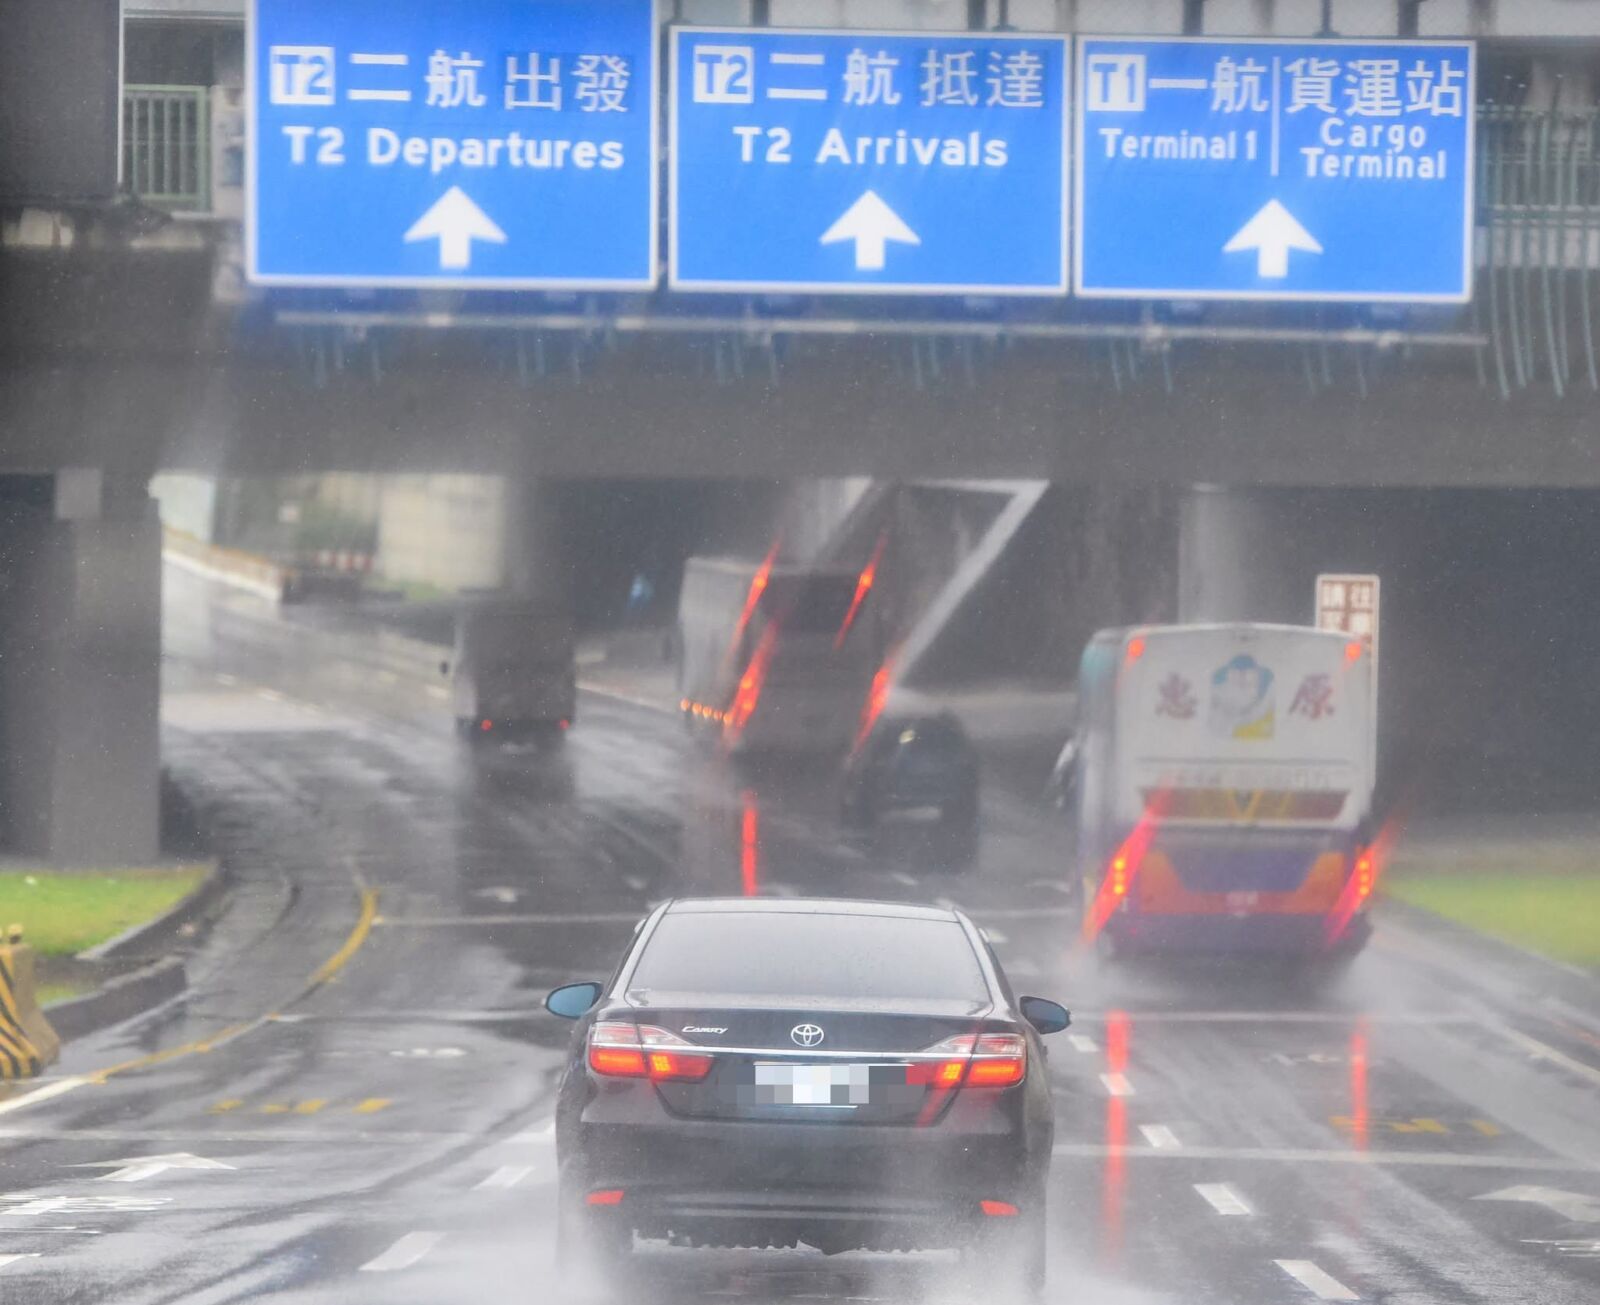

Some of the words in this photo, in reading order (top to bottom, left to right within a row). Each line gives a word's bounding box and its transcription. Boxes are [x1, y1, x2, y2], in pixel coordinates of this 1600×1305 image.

[272, 50, 334, 100] T2
[347, 49, 631, 113] 二航出發
[695, 50, 751, 99] T2
[766, 48, 1044, 108] 二航抵達
[1091, 58, 1141, 107] T1
[1148, 55, 1270, 114] 一航
[1283, 57, 1465, 118] 貨運站
[281, 125, 345, 164] T2
[367, 127, 625, 175] Departures
[732, 126, 792, 163] T2
[815, 128, 1008, 167] Arrivals
[1099, 127, 1237, 160] Terminal
[1245, 129, 1258, 161] 1
[1320, 117, 1426, 153] Cargo
[1301, 147, 1447, 180] Terminal
